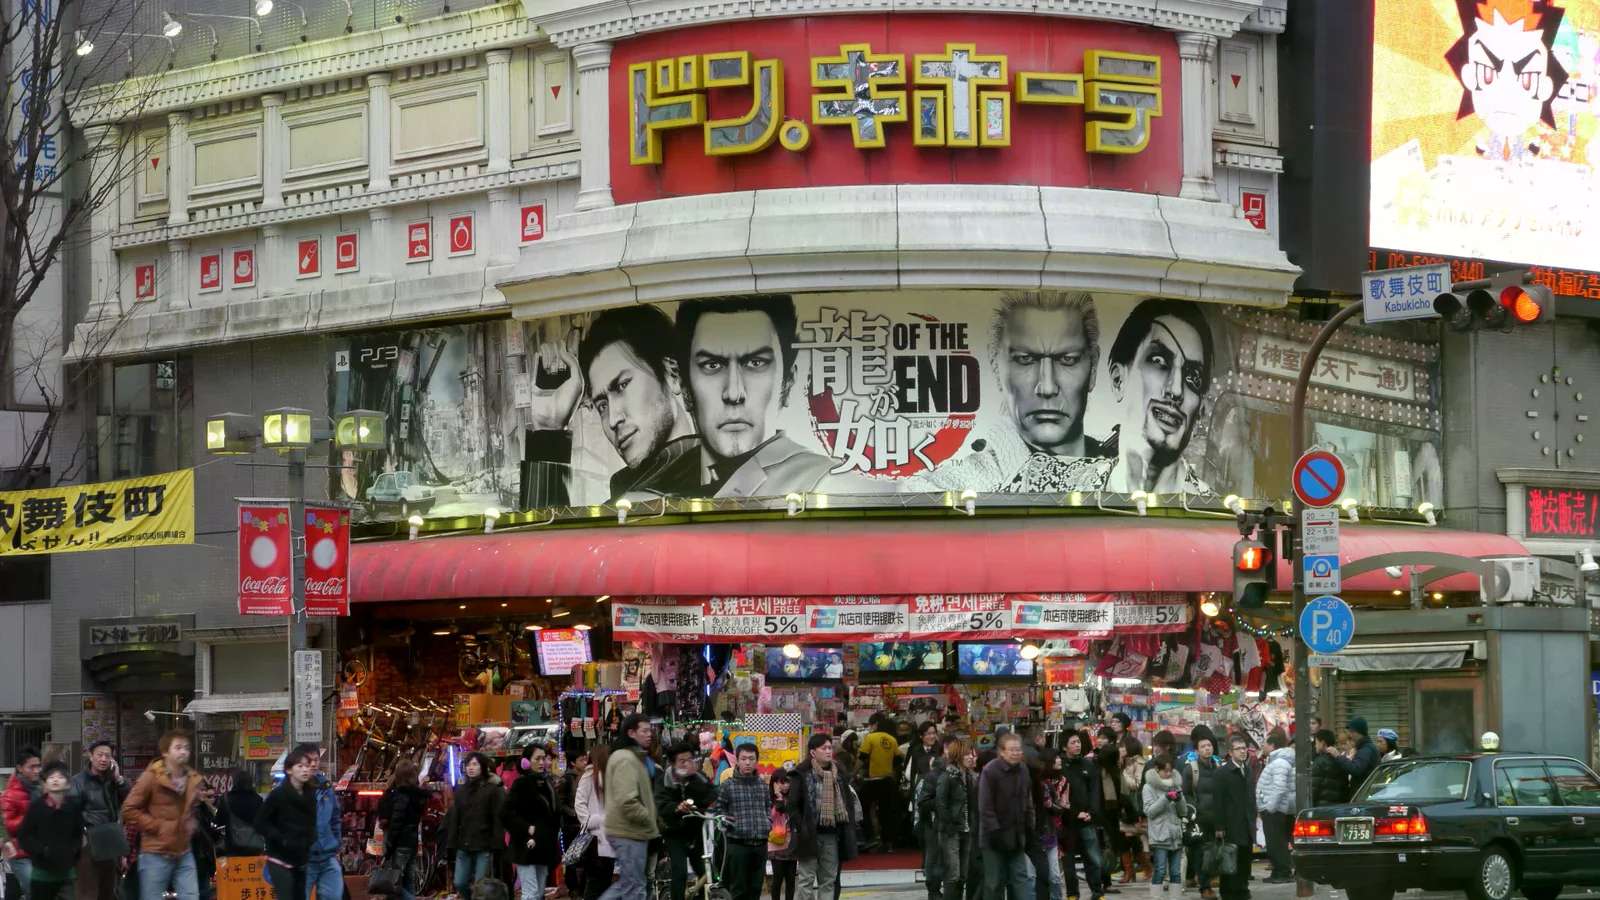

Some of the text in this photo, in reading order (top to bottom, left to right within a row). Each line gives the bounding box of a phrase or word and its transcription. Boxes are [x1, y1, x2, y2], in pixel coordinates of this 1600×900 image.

[1370, 272, 1443, 300] 歌舞伎町
[1385, 299, 1431, 313] Kabukicho
[893, 323, 968, 350] OF THE
[361, 346, 398, 362] PS3
[893, 355, 981, 413] END
[241, 576, 289, 595] Coca-Cola
[305, 577, 346, 595] Coca-Cola
[773, 597, 800, 605] DUTY
[979, 594, 1006, 602] DUTY
[979, 602, 1005, 610] FREE
[1316, 601, 1339, 609] 7-20
[773, 606, 800, 614] FREE
[1043, 609, 1109, 623] 本店可使用银联卡
[1155, 606, 1181, 623] 5%
[640, 612, 698, 627] 本店可使用银联卡
[764, 616, 798, 633] 5%
[838, 612, 904, 626] 本店可使用银联卡
[969, 612, 1003, 630] 5%
[1312, 610, 1332, 645] P
[1326, 629, 1342, 645] 40
[304, 653, 314, 730] 防犯カメラ作動中
[201, 741, 212, 752] 6F
[1348, 829, 1370, 840] 73-58
